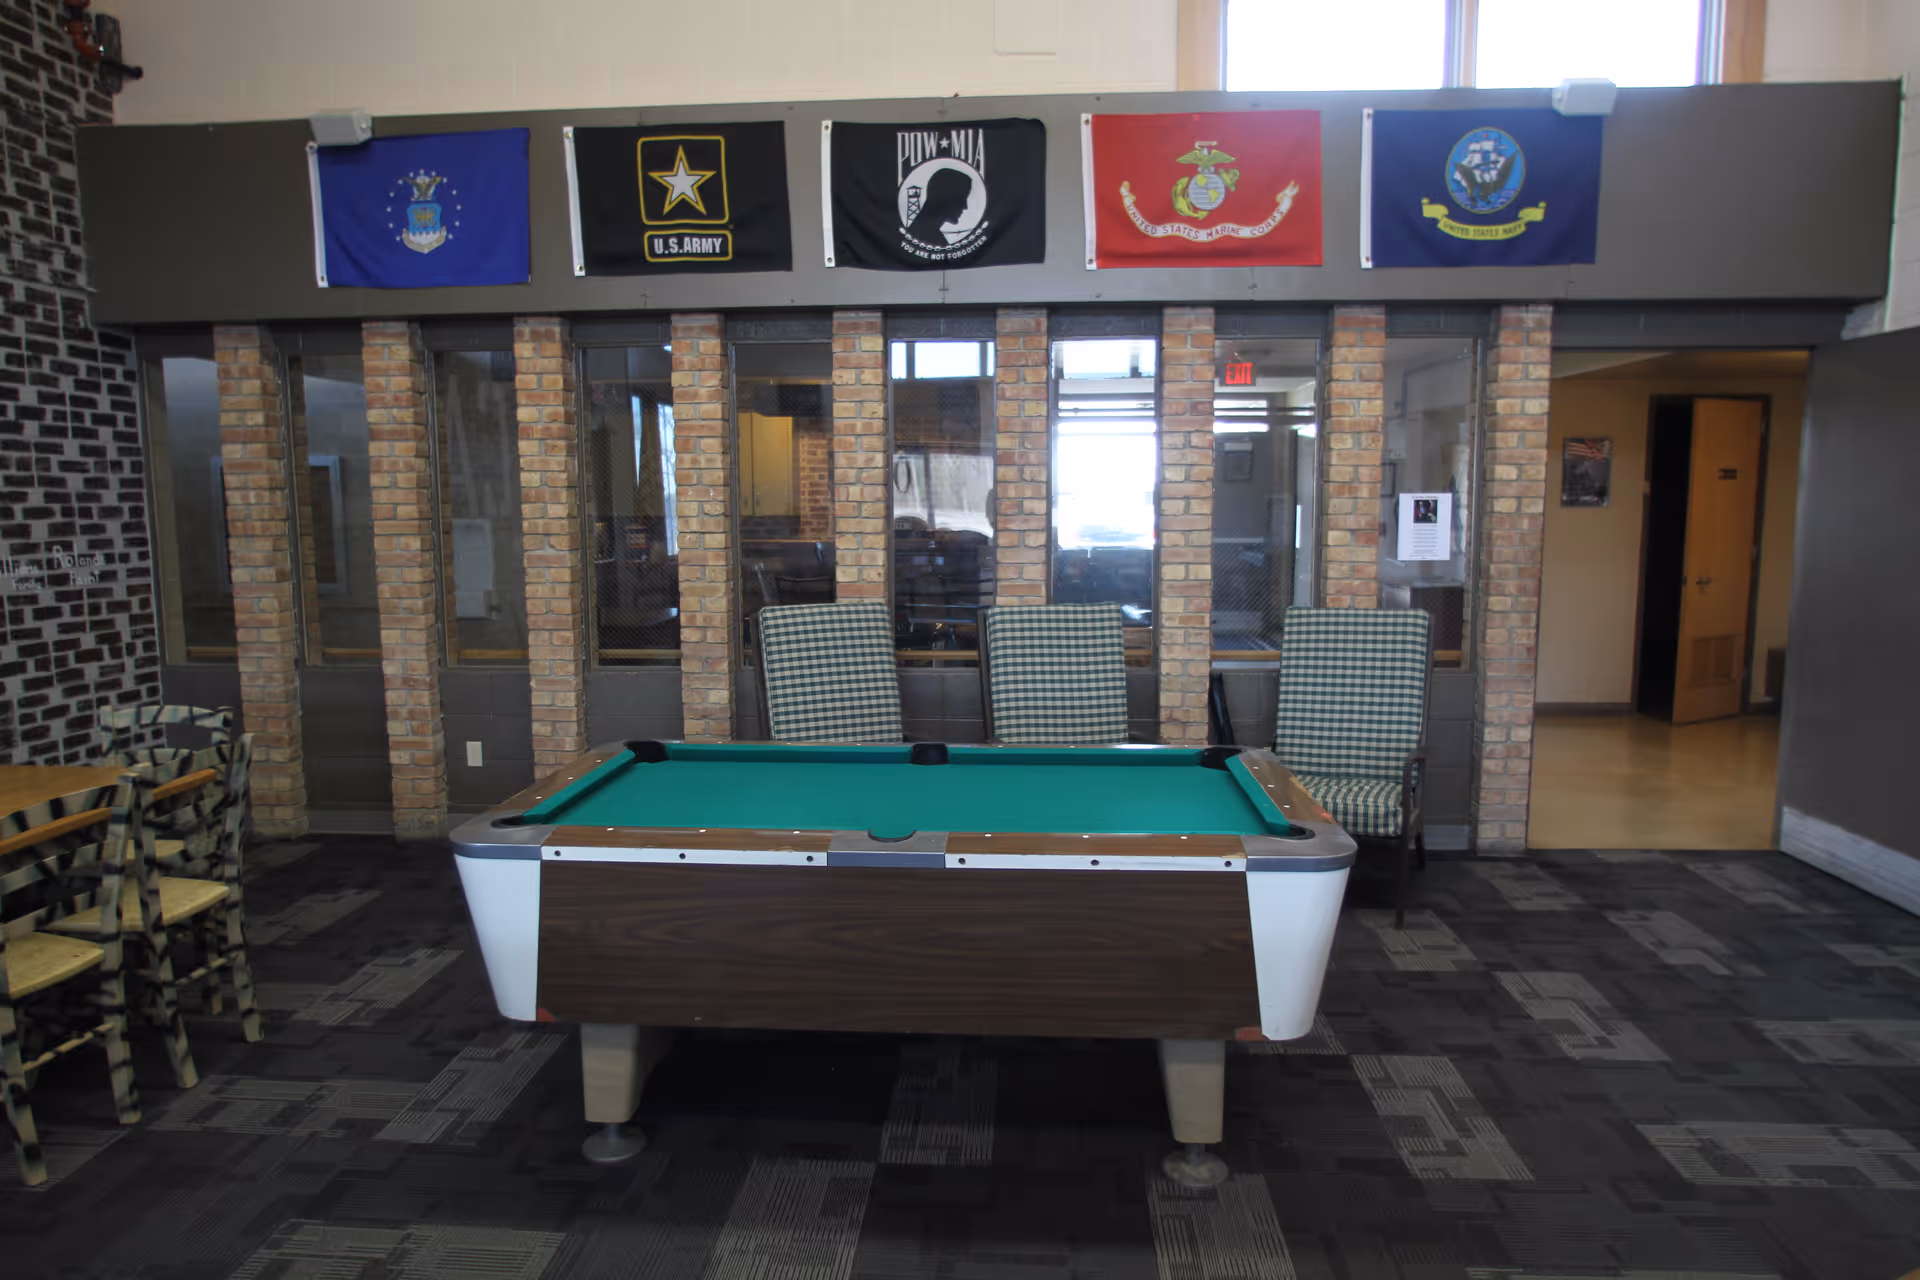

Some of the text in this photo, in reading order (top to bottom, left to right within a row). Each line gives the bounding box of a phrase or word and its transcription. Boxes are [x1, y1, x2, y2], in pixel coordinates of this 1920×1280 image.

[896, 128, 985, 188] POW MIA
[1128, 204, 1284, 240] UNITED STATES MARINE CORPS
[1442, 220, 1522, 238] UNITED STATES NAVY
[900, 235, 988, 261] YOU ARE NOT FORGOTTEN
[1225, 362, 1253, 385] EXIT
